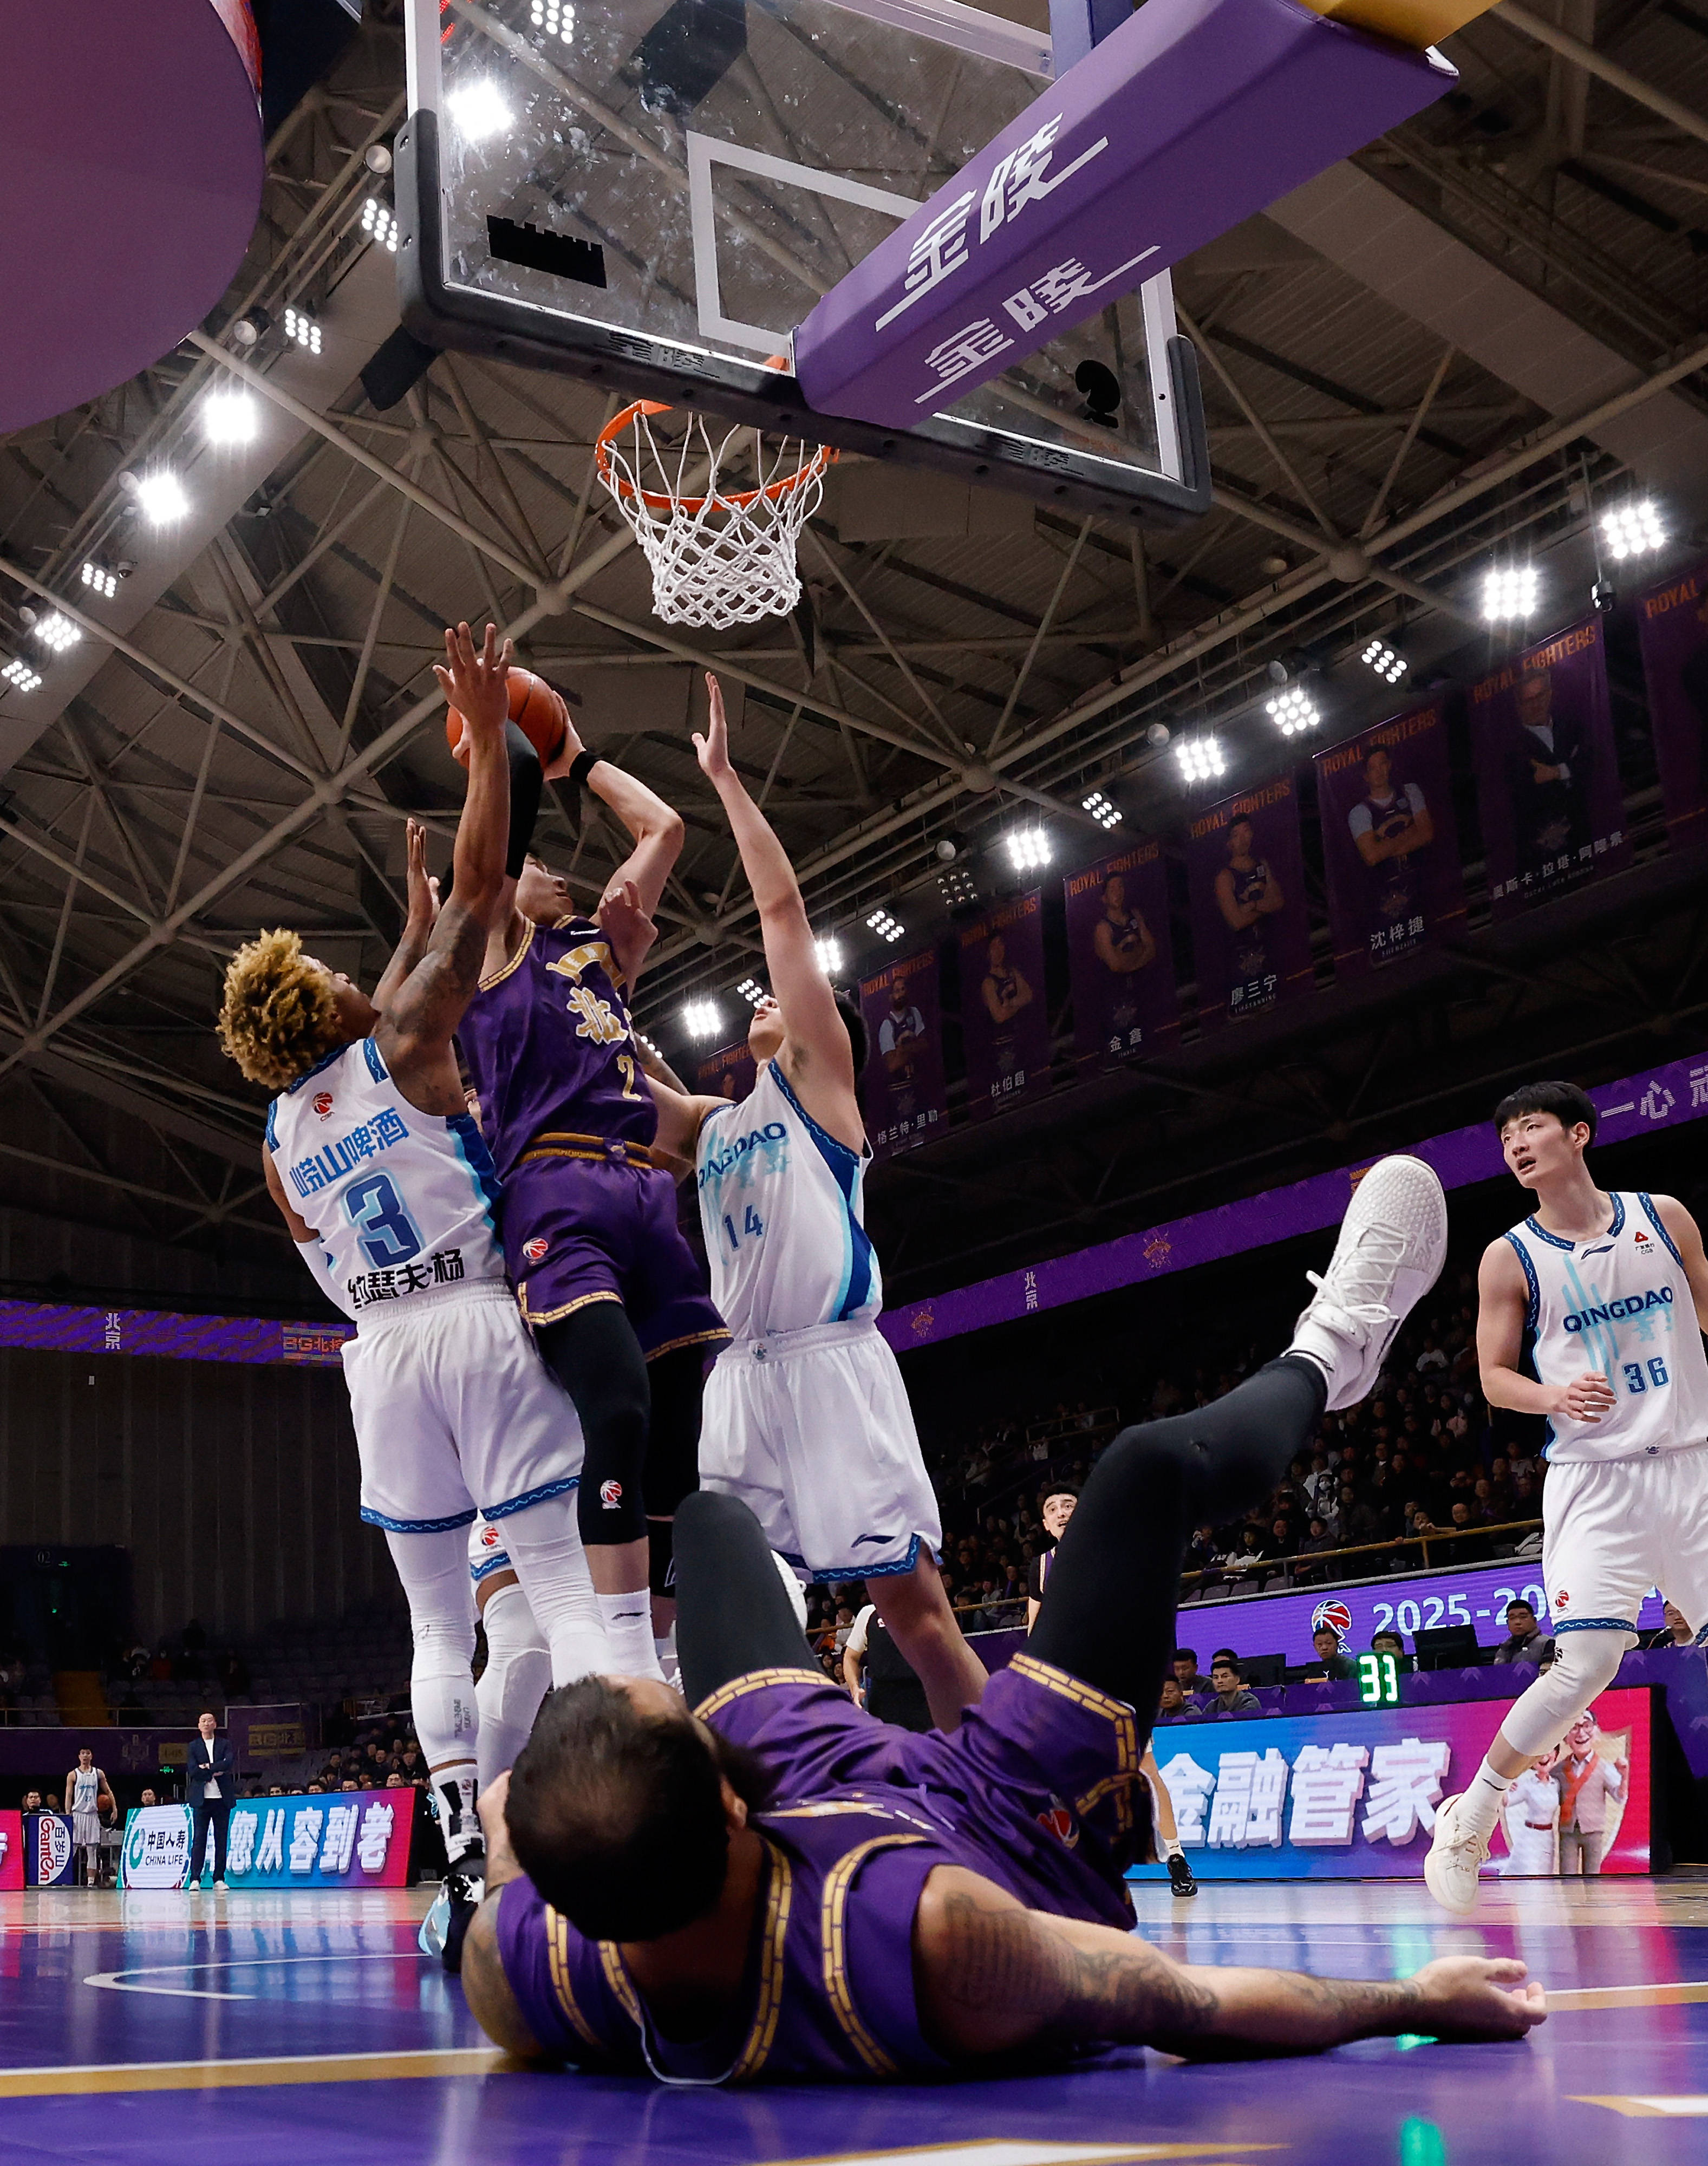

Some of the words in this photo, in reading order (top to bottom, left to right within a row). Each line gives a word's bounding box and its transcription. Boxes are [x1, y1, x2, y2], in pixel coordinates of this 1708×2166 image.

[1645, 577, 1699, 619] ROYAL
[1474, 667, 1516, 704] ROYAL
[1522, 625, 1596, 671] FIGHTERS
[1321, 745, 1364, 777] ROYAL
[1191, 810, 1228, 838] ROYAL
[1070, 870, 1104, 897] ROYAL
[1370, 915, 1425, 951] 沈梓捷
[1230, 974, 1278, 1006] 廖三宁
[566, 987, 638, 1054] 北
[289, 1106, 410, 1198] 崂山啤酒
[343, 1171, 423, 1269] 3
[724, 1204, 764, 1249] 14
[1024, 1271, 1038, 1310] 北京
[1563, 1286, 1673, 1333] QINGDAO
[105, 1313, 121, 1350] 北京
[1622, 1355, 1670, 1394] 36
[1359, 1654, 1398, 1702] 33
[1158, 1737, 1452, 1849] 金融管家
[55, 1826, 66, 1868] 百岁山
[147, 1830, 186, 1850] 中国人寿
[201, 1802, 394, 1875] 您从容到老
[145, 1855, 166, 1866] CHINA
[168, 1854, 184, 1865] LIFE
